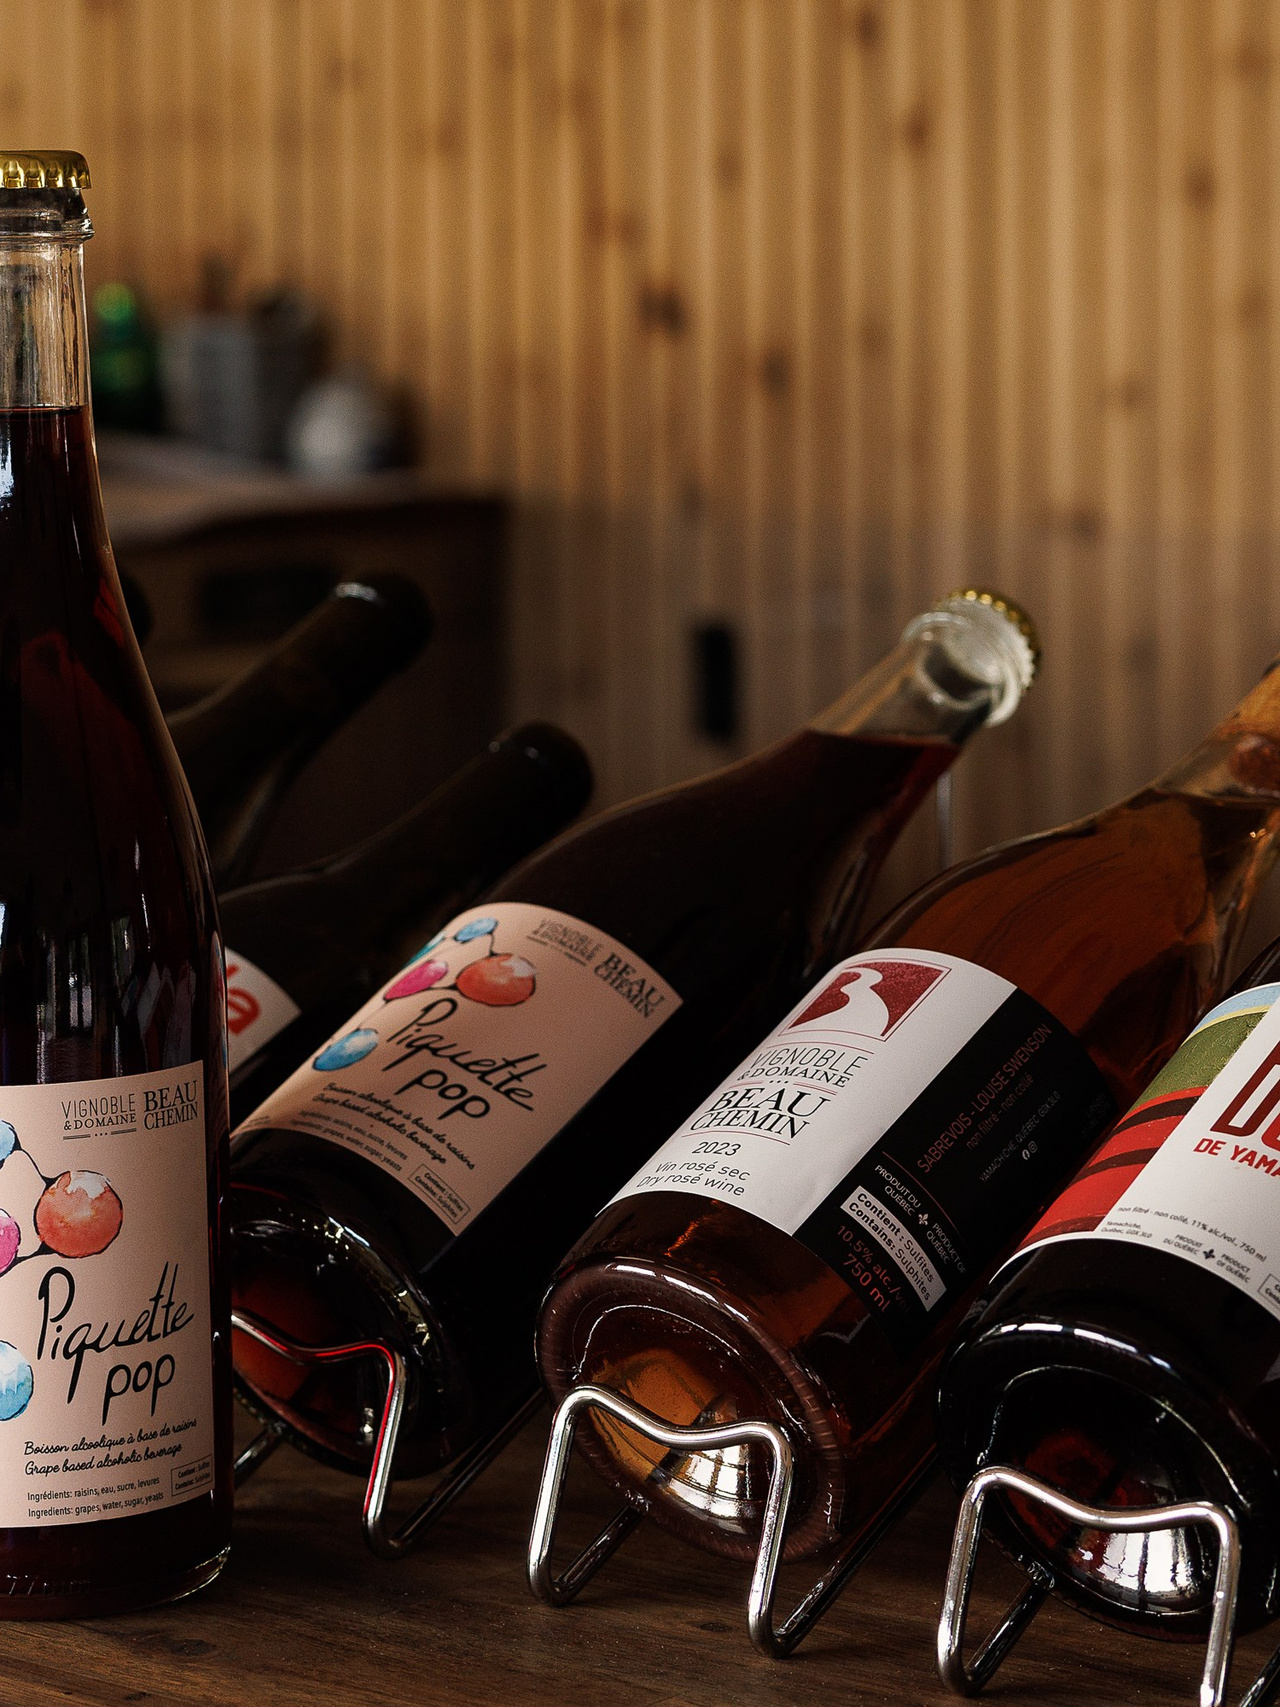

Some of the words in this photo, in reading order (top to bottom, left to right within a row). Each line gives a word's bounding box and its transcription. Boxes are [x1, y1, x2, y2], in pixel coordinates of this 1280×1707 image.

[594, 964, 655, 1018] CHEMIN
[603, 952, 666, 1006] BEAU
[382, 998, 547, 1111] Piquette
[750, 1047, 868, 1077] VIGNOBLE
[394, 1069, 490, 1120] pop
[749, 1066, 850, 1088] DOMAINE
[61, 1093, 136, 1119] VIGNOBLE
[143, 1080, 197, 1113] BEAU
[706, 1087, 831, 1118] BEAU
[917, 1111, 972, 1173] SABREVOIS
[971, 1070, 1010, 1112] LOUISE
[1002, 1023, 1053, 1078] SWENSON
[966, 1130, 985, 1150] non
[1001, 1091, 1020, 1112] non
[1014, 1071, 1035, 1100] collé
[73, 1112, 137, 1130] DOMAINE
[144, 1102, 198, 1131] CHEMIN
[690, 1109, 811, 1139] CHEMIN
[691, 1141, 742, 1157] 2023
[1193, 1138, 1227, 1156] DE
[636, 1173, 664, 1188] Dry
[664, 1171, 704, 1185] rosé
[704, 1176, 746, 1196] wine
[655, 1161, 677, 1174] Vin
[678, 1159, 717, 1173] rosé
[718, 1164, 751, 1181] sec
[874, 1165, 910, 1197] PRODUIT
[908, 1193, 922, 1209] DU
[884, 1185, 916, 1216] QUÉBEC
[837, 1225, 873, 1264] 10.5%
[849, 1202, 896, 1250] Contains:
[895, 1247, 931, 1301] Sulphites
[857, 1193, 901, 1237] Contient
[903, 1239, 934, 1283] Sulfites
[926, 1230, 951, 1264] QUÉBEC
[932, 1222, 959, 1262] PRODUCT
[1154, 1210, 1169, 1219] non
[1191, 1219, 1208, 1231] 11%
[1239, 1240, 1256, 1255] 750
[1255, 1251, 1267, 1262] ml
[843, 1253, 873, 1287] 750
[869, 1287, 891, 1313] ml
[37, 1261, 195, 1404] Piquette
[102, 1354, 176, 1426] pop
[24, 1441, 70, 1456] Boisson
[71, 1434, 126, 1452] alcoolique
[127, 1433, 135, 1445] à
[136, 1428, 159, 1443] base
[159, 1424, 171, 1437] de
[171, 1418, 197, 1434] raisins
[25, 1461, 60, 1478] Grape
[62, 1456, 95, 1472] based
[96, 1450, 143, 1469] alcoholic
[143, 1443, 182, 1462] beverage
[27, 1489, 73, 1503] Ingrédients:
[74, 1487, 100, 1498] raisins,
[100, 1485, 116, 1494] eau,
[117, 1482, 136, 1492] sucre,
[137, 1475, 160, 1489] levures
[28, 1507, 74, 1519] Ingredients:
[75, 1503, 102, 1516] grapes,
[102, 1499, 124, 1511] water,
[124, 1496, 144, 1509] sugar,
[144, 1491, 164, 1506] yeasts
